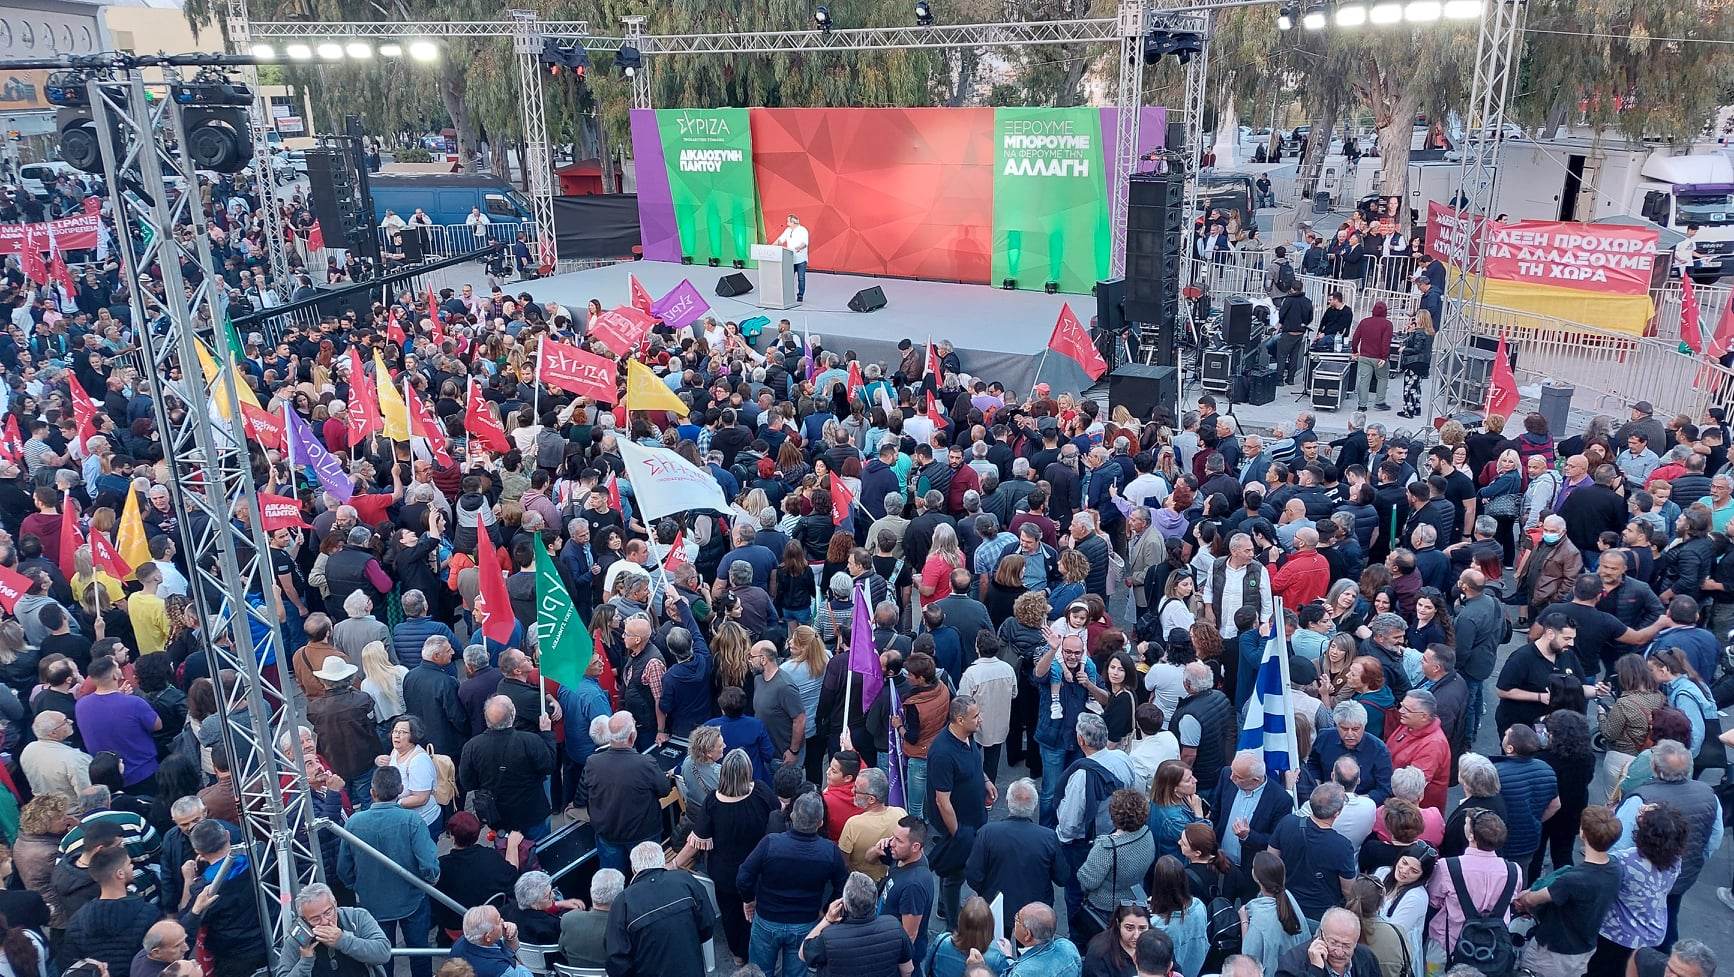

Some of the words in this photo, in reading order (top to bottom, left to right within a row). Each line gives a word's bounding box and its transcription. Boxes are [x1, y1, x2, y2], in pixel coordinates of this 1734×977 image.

[676, 110, 731, 135] ΣΥΡΙΖΑ
[1004, 120, 1074, 135] ΞΕΡΟΥΜΕ
[1004, 135, 1090, 149] ΜΠΟΡΟΥΜΕ
[680, 149, 743, 162] ΔΙΚΑΙΟΣΥΝΗ
[1004, 150, 1017, 158] ΝΑ
[1019, 150, 1063, 158] ΦΕΡΟΥΜΕ
[1066, 150, 1084, 158] ΤΗΝ
[680, 160, 722, 172] ΠΑΝΤΟΥ
[1004, 159, 1089, 177] ΑΛΛΑΓΗ
[1553, 233, 1658, 254] ΠΡΟΧΩΡΑ
[1516, 247, 1652, 271] ΑΛΛΑΞΟΥΜΕ
[1518, 261, 1544, 277] ΤΗ
[1549, 264, 1607, 283] ΧΩΡΑ
[546, 351, 611, 385] ΣΥΡΙΖΑ
